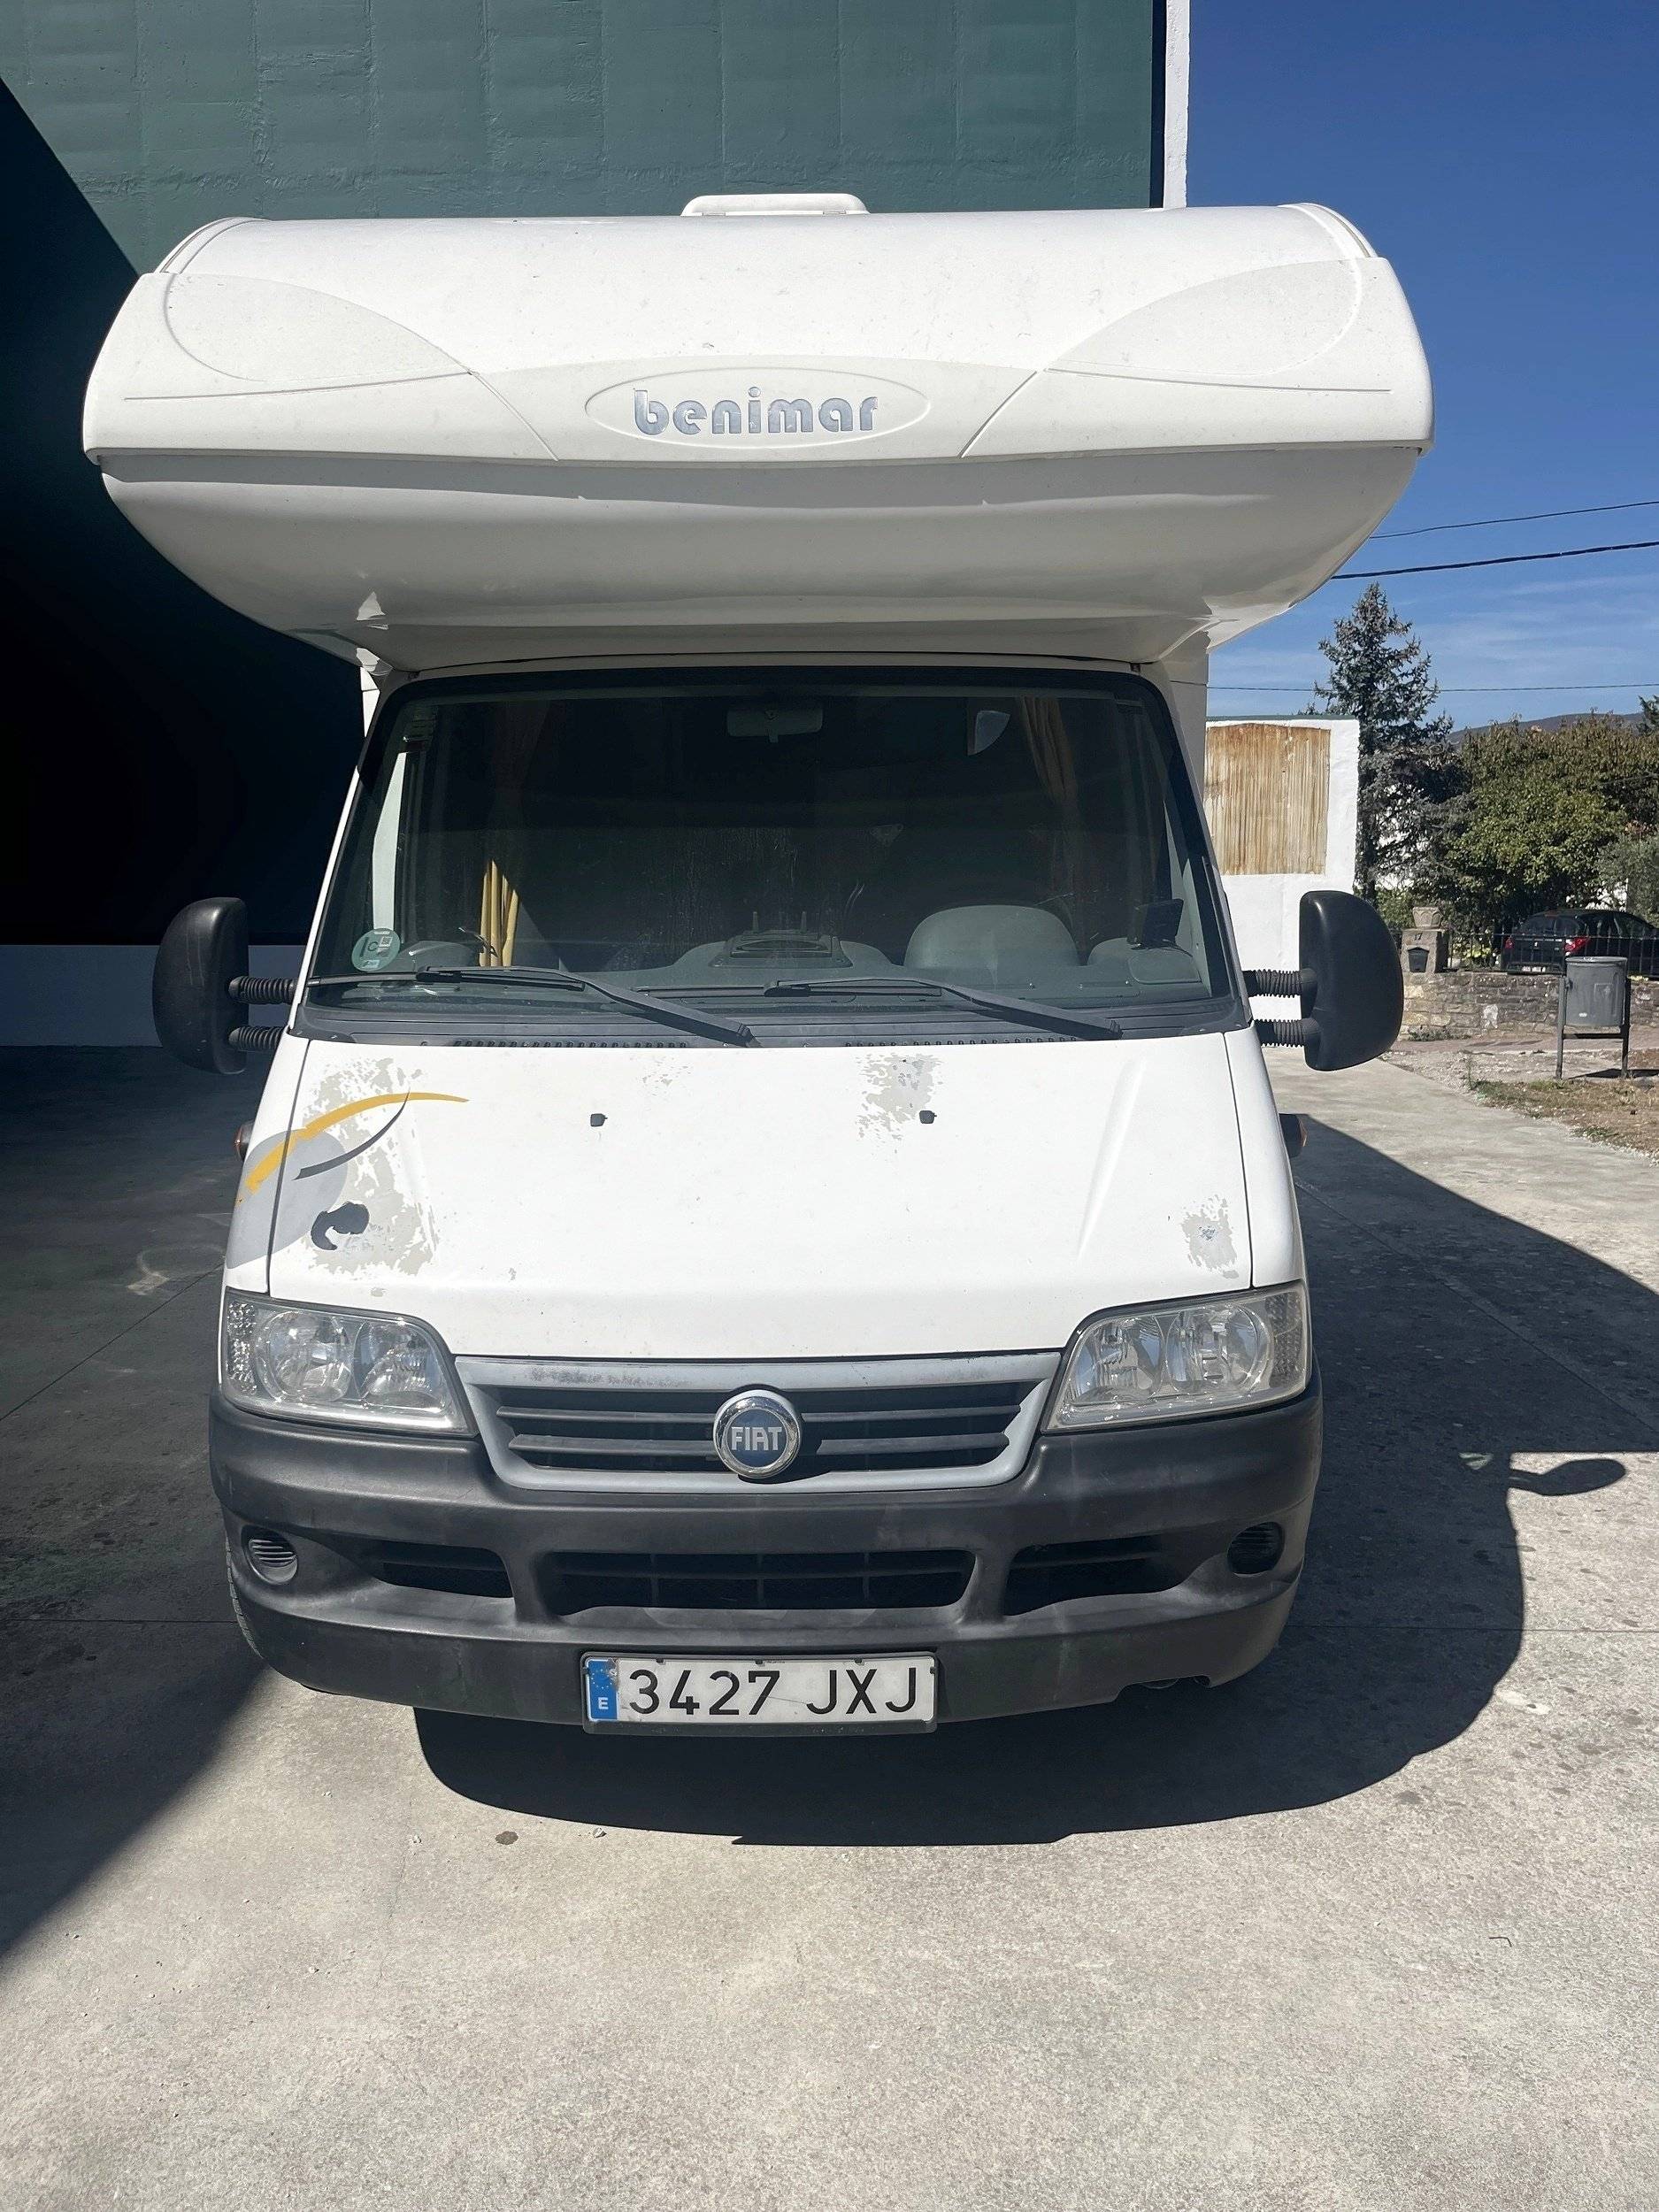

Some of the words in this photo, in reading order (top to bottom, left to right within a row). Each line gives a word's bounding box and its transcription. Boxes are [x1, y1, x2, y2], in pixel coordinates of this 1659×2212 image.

[633, 386, 879, 436] benimar
[731, 1426, 782, 1451] FIAT
[597, 1696, 609, 1710] E
[628, 1669, 780, 1716] 3427
[805, 1667, 917, 1715] JXJ
